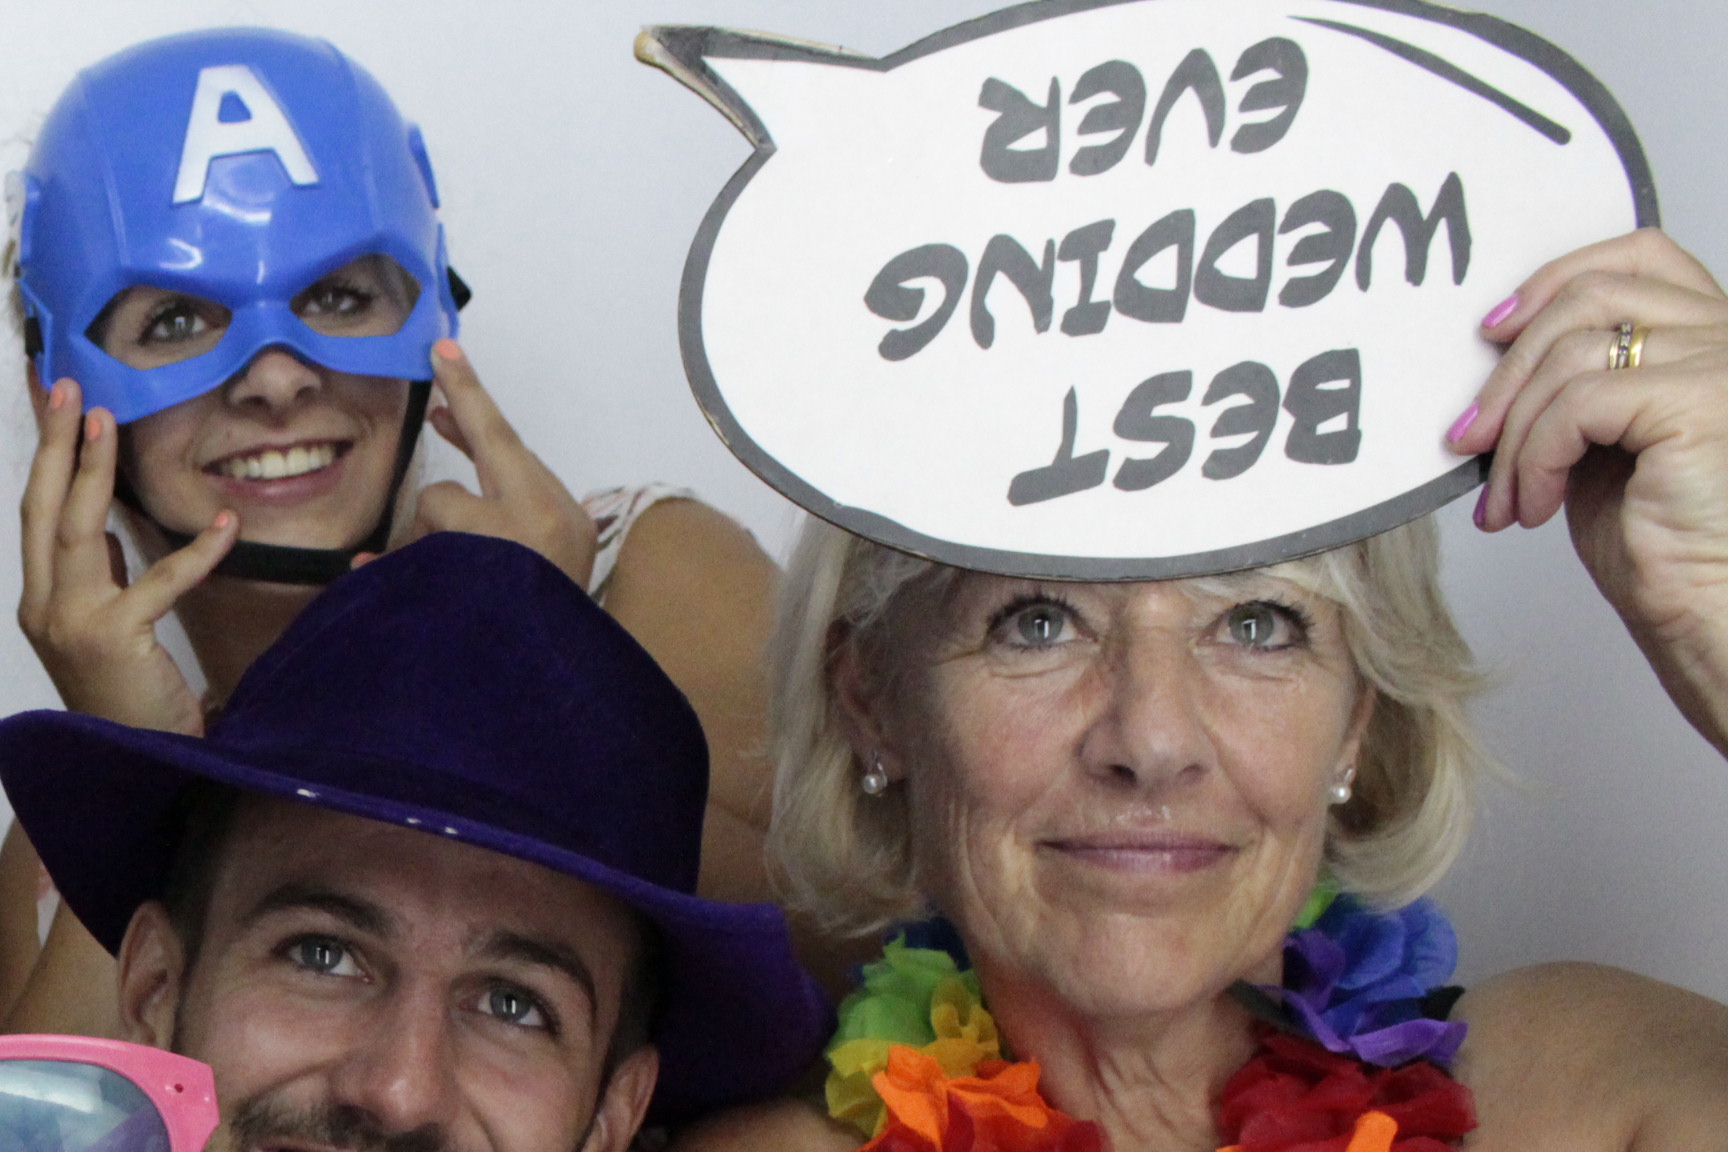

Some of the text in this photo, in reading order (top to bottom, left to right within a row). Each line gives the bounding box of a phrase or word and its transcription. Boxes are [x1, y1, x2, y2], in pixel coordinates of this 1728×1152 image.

[172, 64, 319, 206] A
[980, 37, 1308, 183] EVER
[864, 172, 1472, 361] WEDDING
[1008, 348, 1361, 507] BEST
